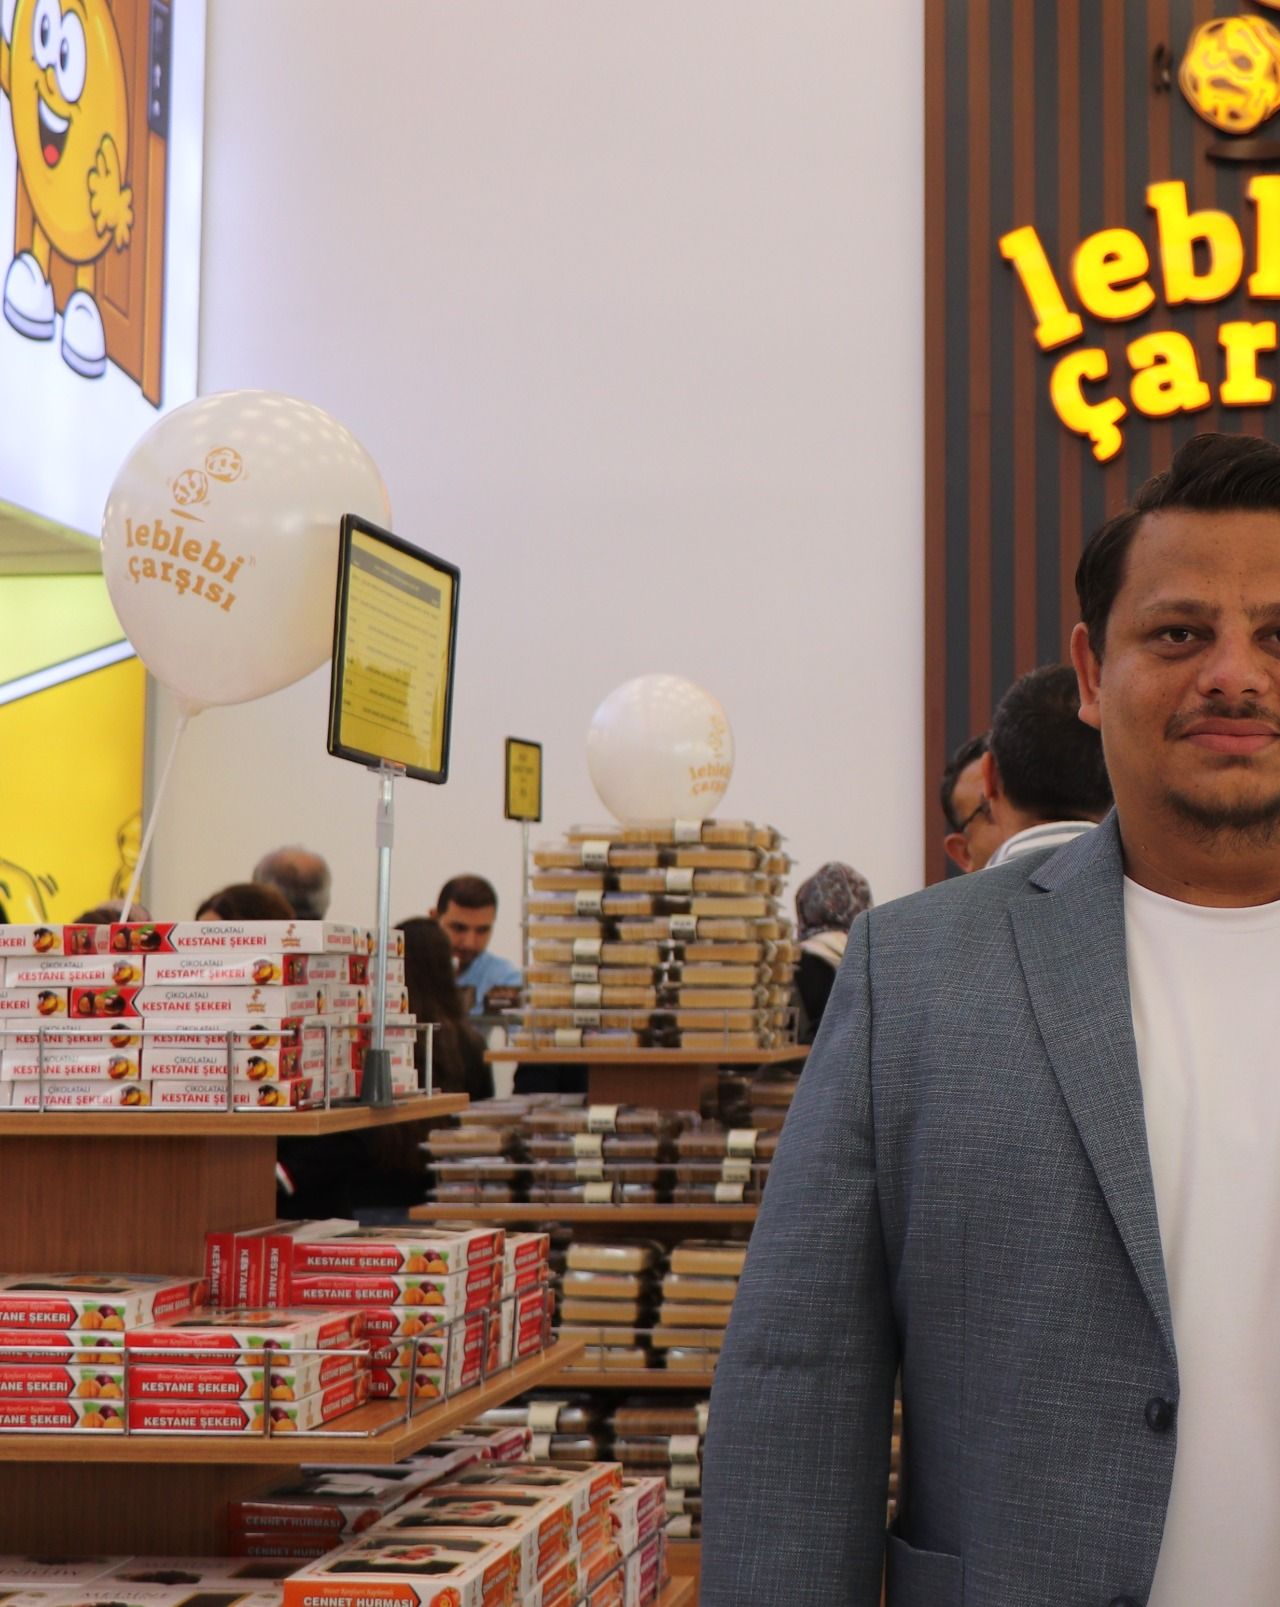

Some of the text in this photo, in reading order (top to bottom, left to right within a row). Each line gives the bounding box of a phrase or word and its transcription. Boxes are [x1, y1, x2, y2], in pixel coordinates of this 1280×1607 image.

[125, 519, 245, 584] leblebi
[128, 556, 237, 613] çarşısı
[201, 927, 244, 935] ÇİKOLATALI
[178, 936, 267, 947] KESTANE ŞEKERİ
[18, 971, 105, 982] KESTANE ŞEKERİ
[157, 970, 205, 978] KESTANE
[165, 991, 209, 999] ÇİKOLATALI
[142, 1001, 231, 1012] KESTANE ŞEKERİ
[152, 1064, 239, 1076] KESTANE ŞEKEİ
[24, 1095, 72, 1104] KETANE
[162, 1093, 250, 1104] KESTANE ŞEERİ
[307, 1257, 398, 1267] KESTANE ŞEKERİ
[303, 1288, 394, 1300] KESTANE ŞEKERİ
[29, 1312, 70, 1323] ŞEKERİ
[27, 1382, 68, 1392] ŞEKERİ
[142, 1382, 240, 1395] KESTANE ŞEKERİ
[30, 1415, 71, 1426] ŞEKERİ
[144, 1416, 242, 1429] KESTANE ŞEKERİ
[303, 1597, 413, 1607] CENNET HURMASI
